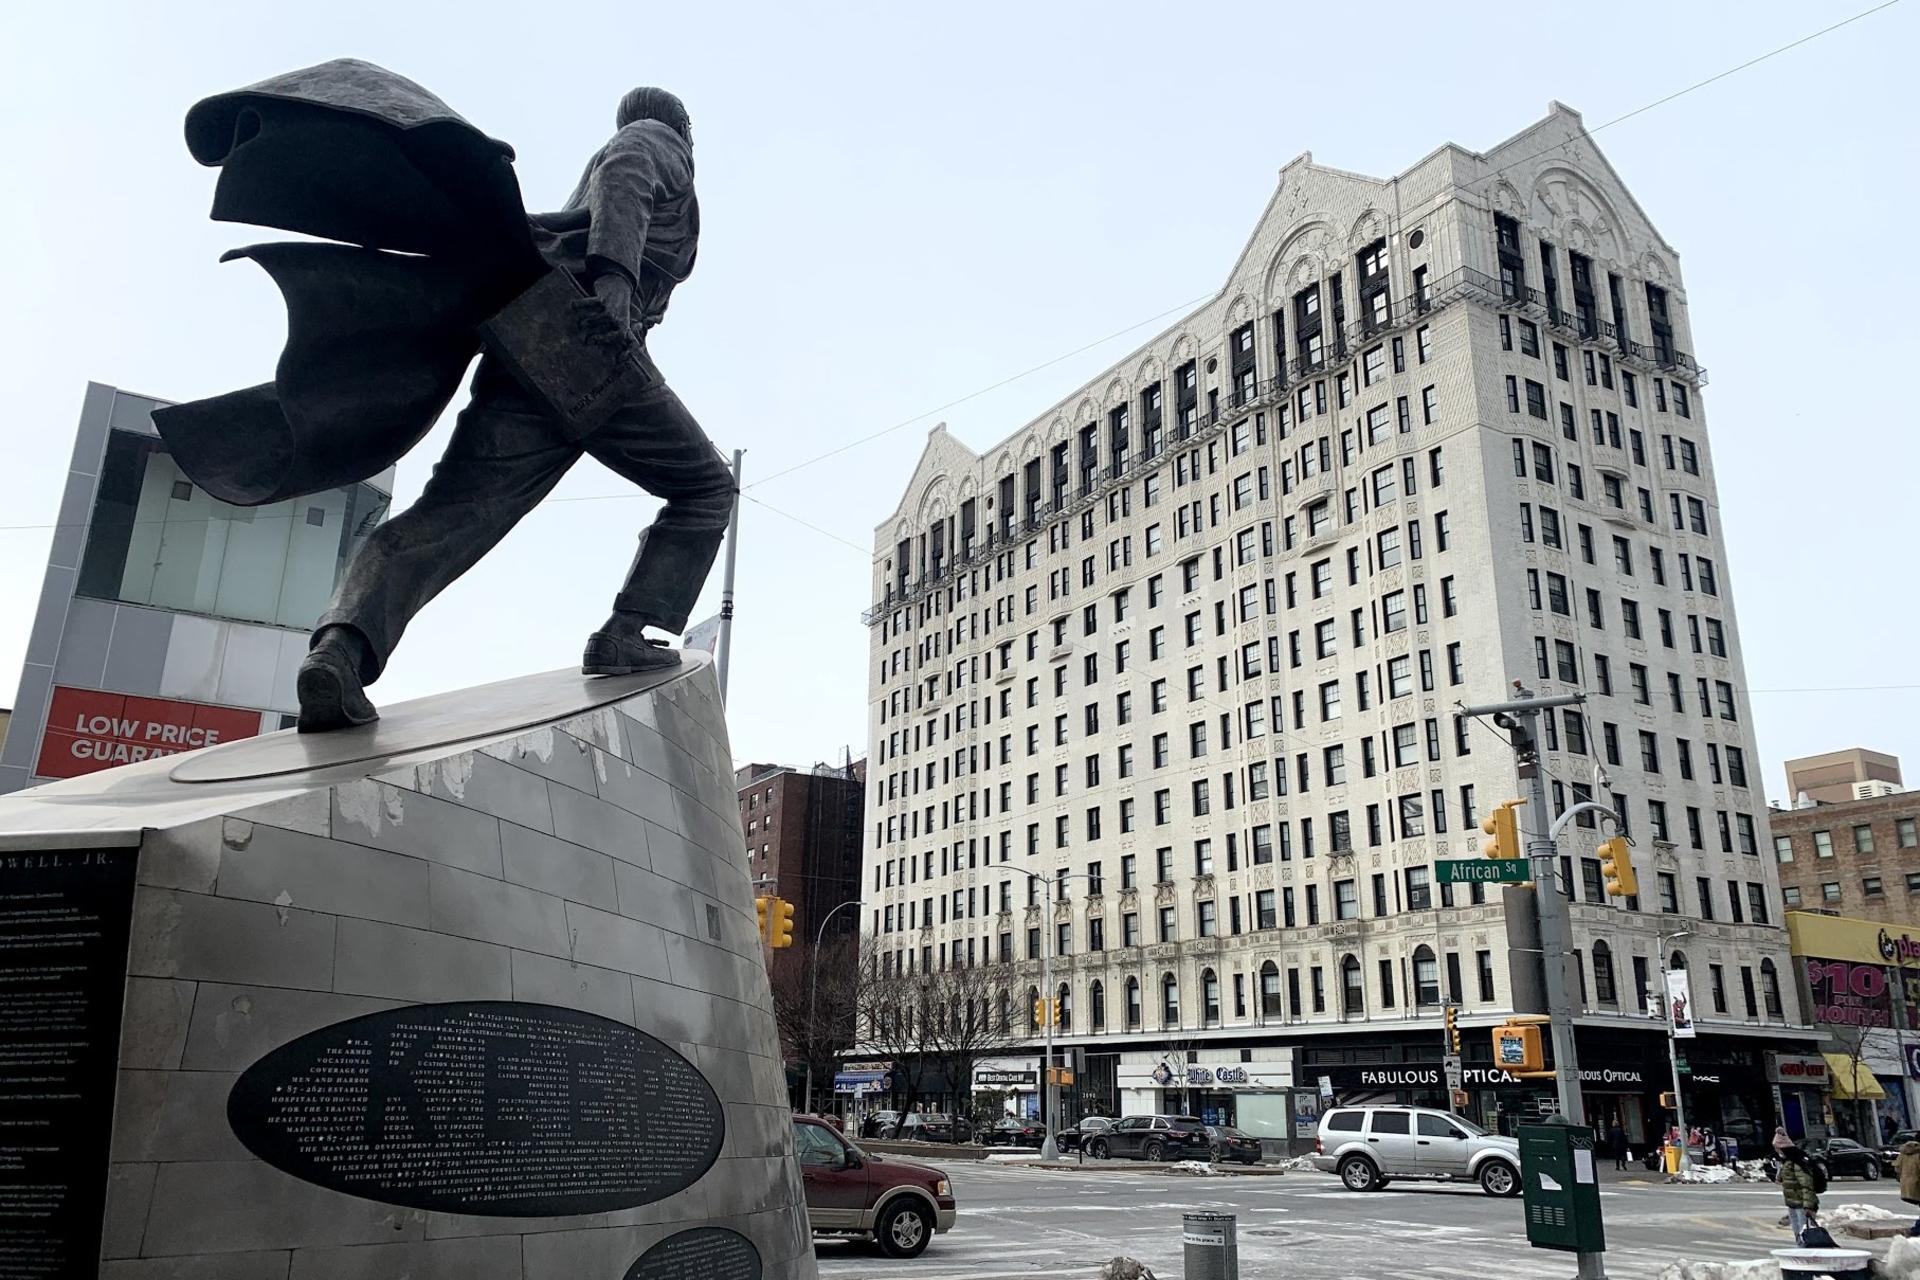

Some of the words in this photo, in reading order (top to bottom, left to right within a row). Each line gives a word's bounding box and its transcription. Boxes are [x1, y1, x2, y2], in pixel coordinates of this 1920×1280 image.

[75, 714, 140, 738] LOW
[145, 722, 219, 747] PRICE
[1450, 863, 1500, 880] African
[1505, 861, 1517, 874] Sq
[1808, 960, 1885, 997] $10
[1187, 1068, 1212, 1083] White
[1216, 1066, 1247, 1083] Castle
[1362, 1070, 1438, 1084] FABULOUS
[1463, 1069, 1521, 1083] PTICA
[1604, 1069, 1642, 1082] OPTICAL
